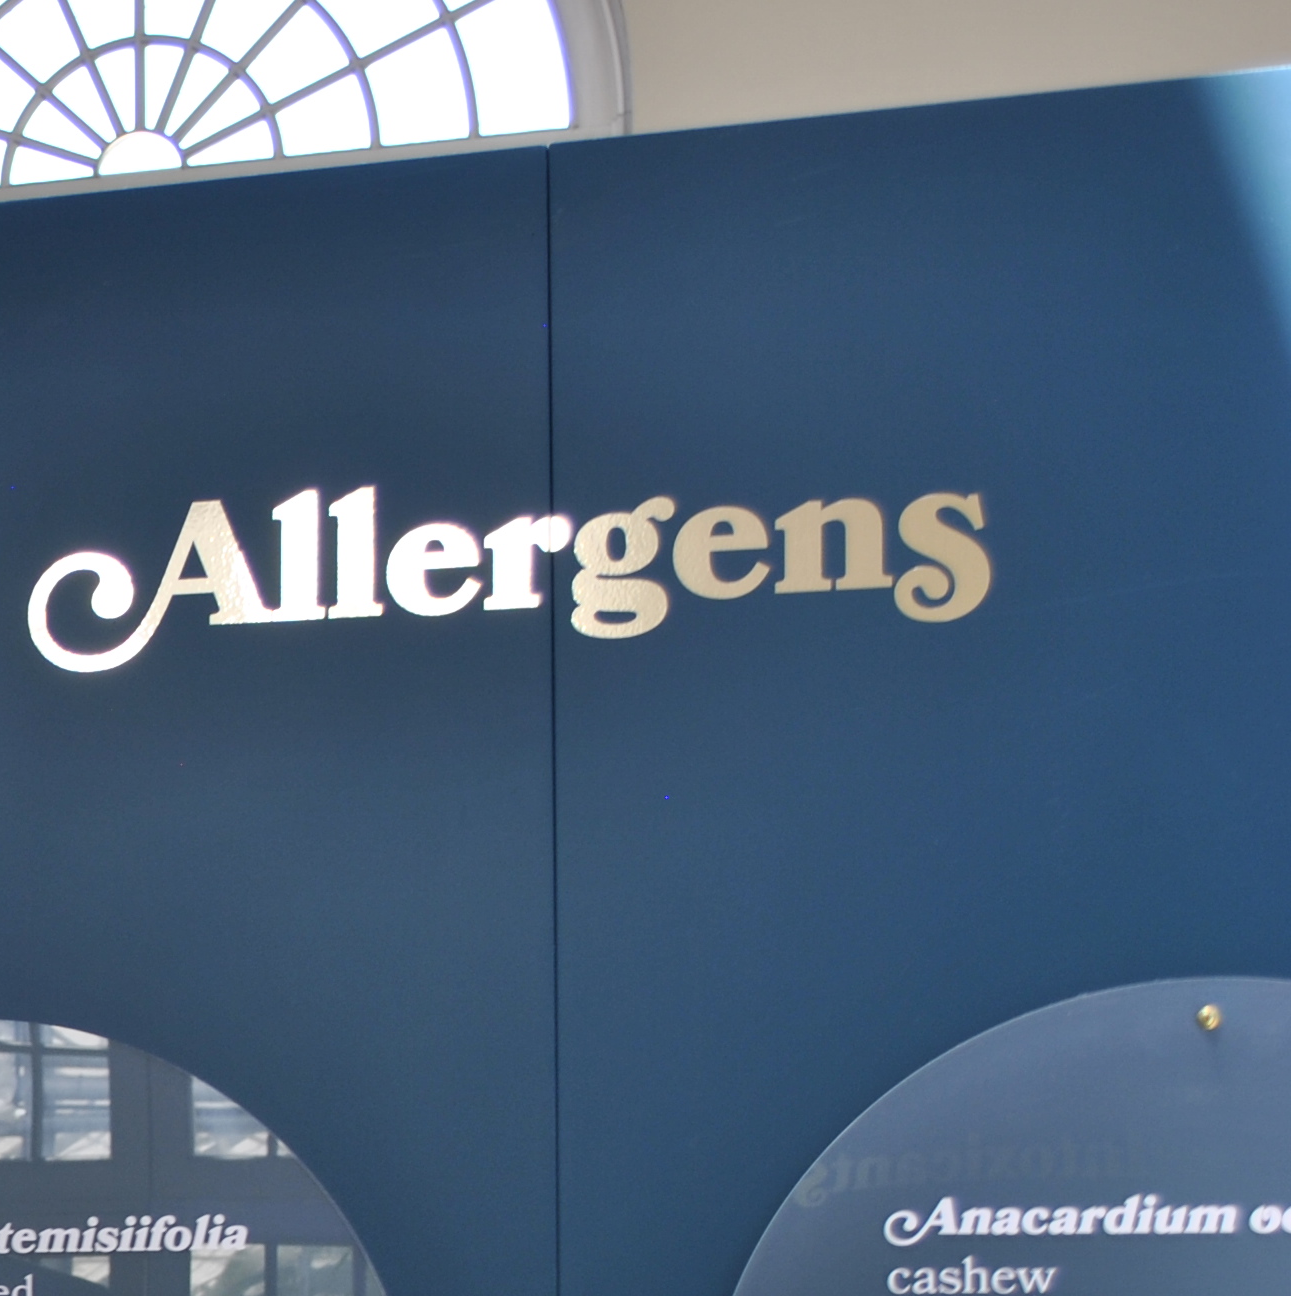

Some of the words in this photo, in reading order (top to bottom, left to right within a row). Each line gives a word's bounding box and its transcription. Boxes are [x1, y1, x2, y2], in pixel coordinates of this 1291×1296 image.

[27, 485, 991, 672] Allergens
[883, 1193, 1237, 1247] Anacardium
[886, 1255, 1058, 1295] cashew
